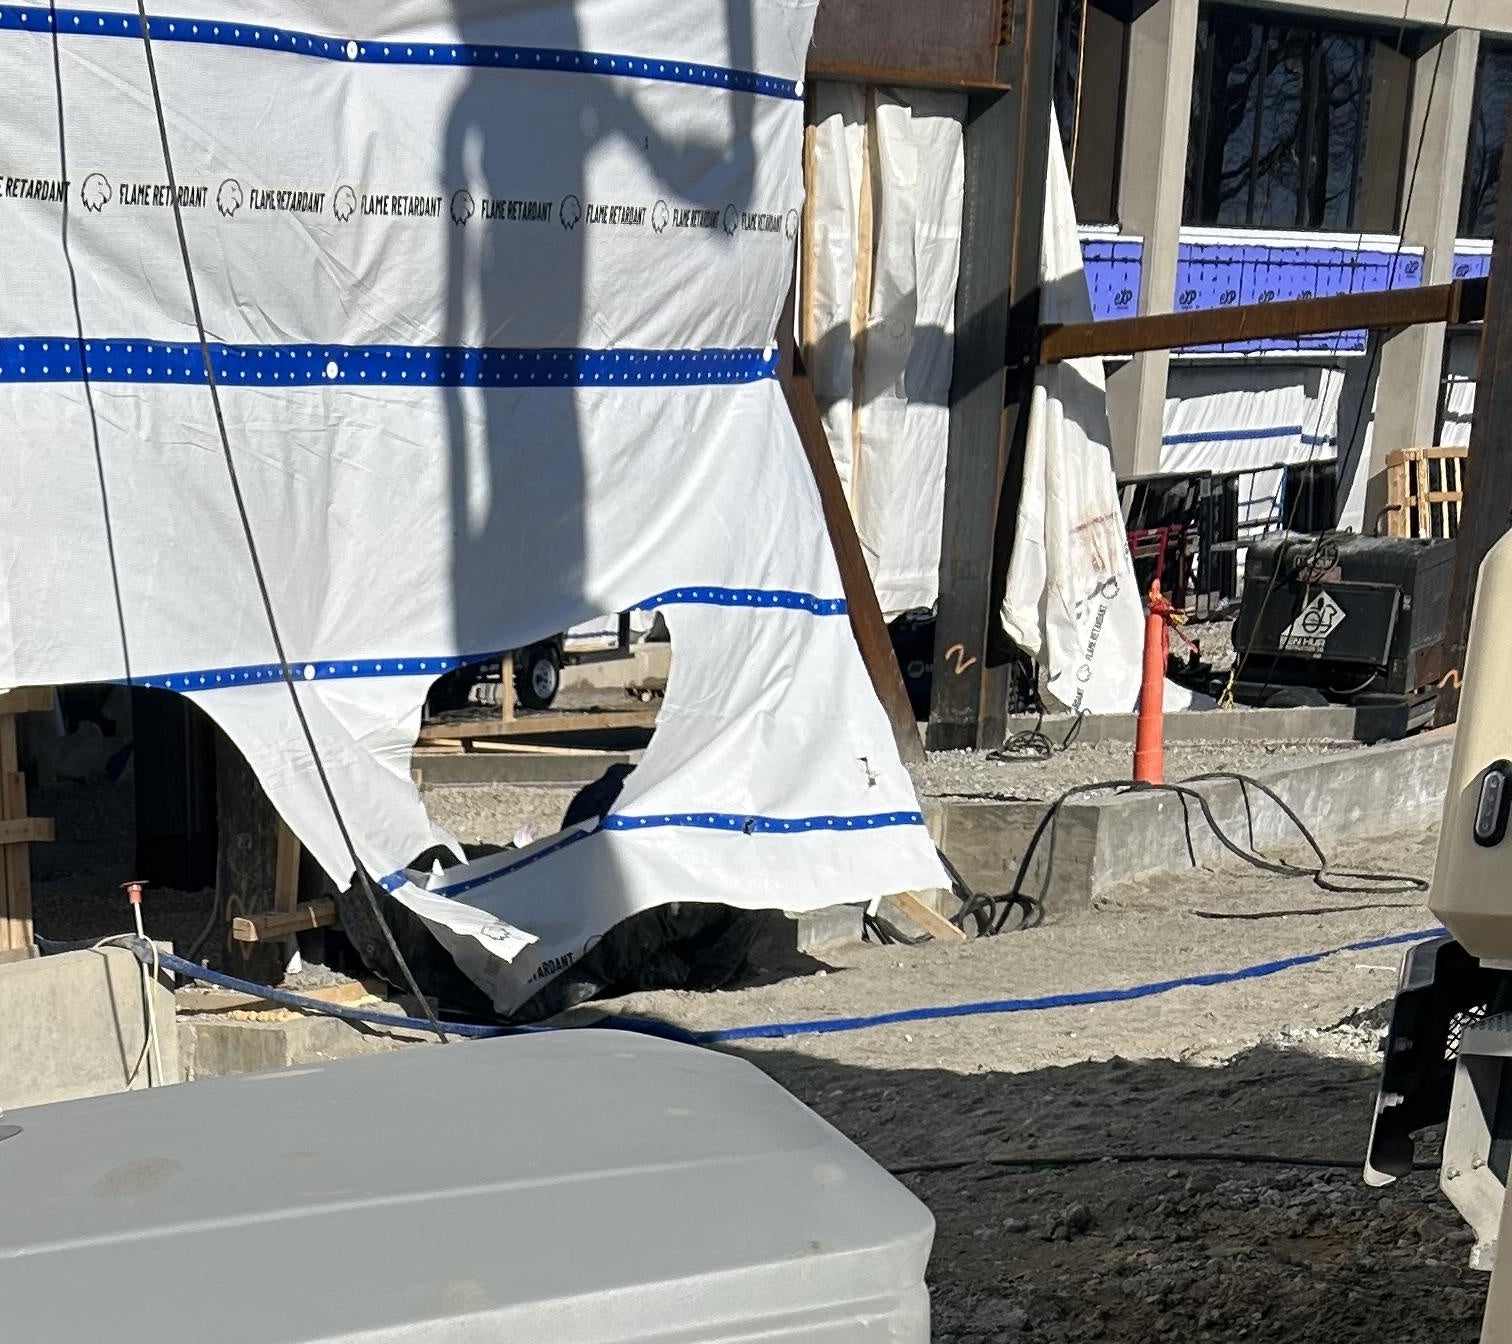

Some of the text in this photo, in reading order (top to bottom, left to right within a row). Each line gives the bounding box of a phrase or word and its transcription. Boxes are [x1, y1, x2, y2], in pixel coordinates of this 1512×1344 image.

[5, 179, 70, 203] RETARDANT
[119, 184, 151, 206] FLAME
[250, 189, 276, 210] FLAME
[276, 190, 325, 214] RETARDANT
[361, 195, 389, 216] FLAME
[391, 196, 442, 217] RETARDANT
[481, 199, 507, 220] FLAME
[507, 200, 553, 222] RETARDANT
[586, 204, 608, 224] FLAME
[608, 205, 647, 226] RETARDANT
